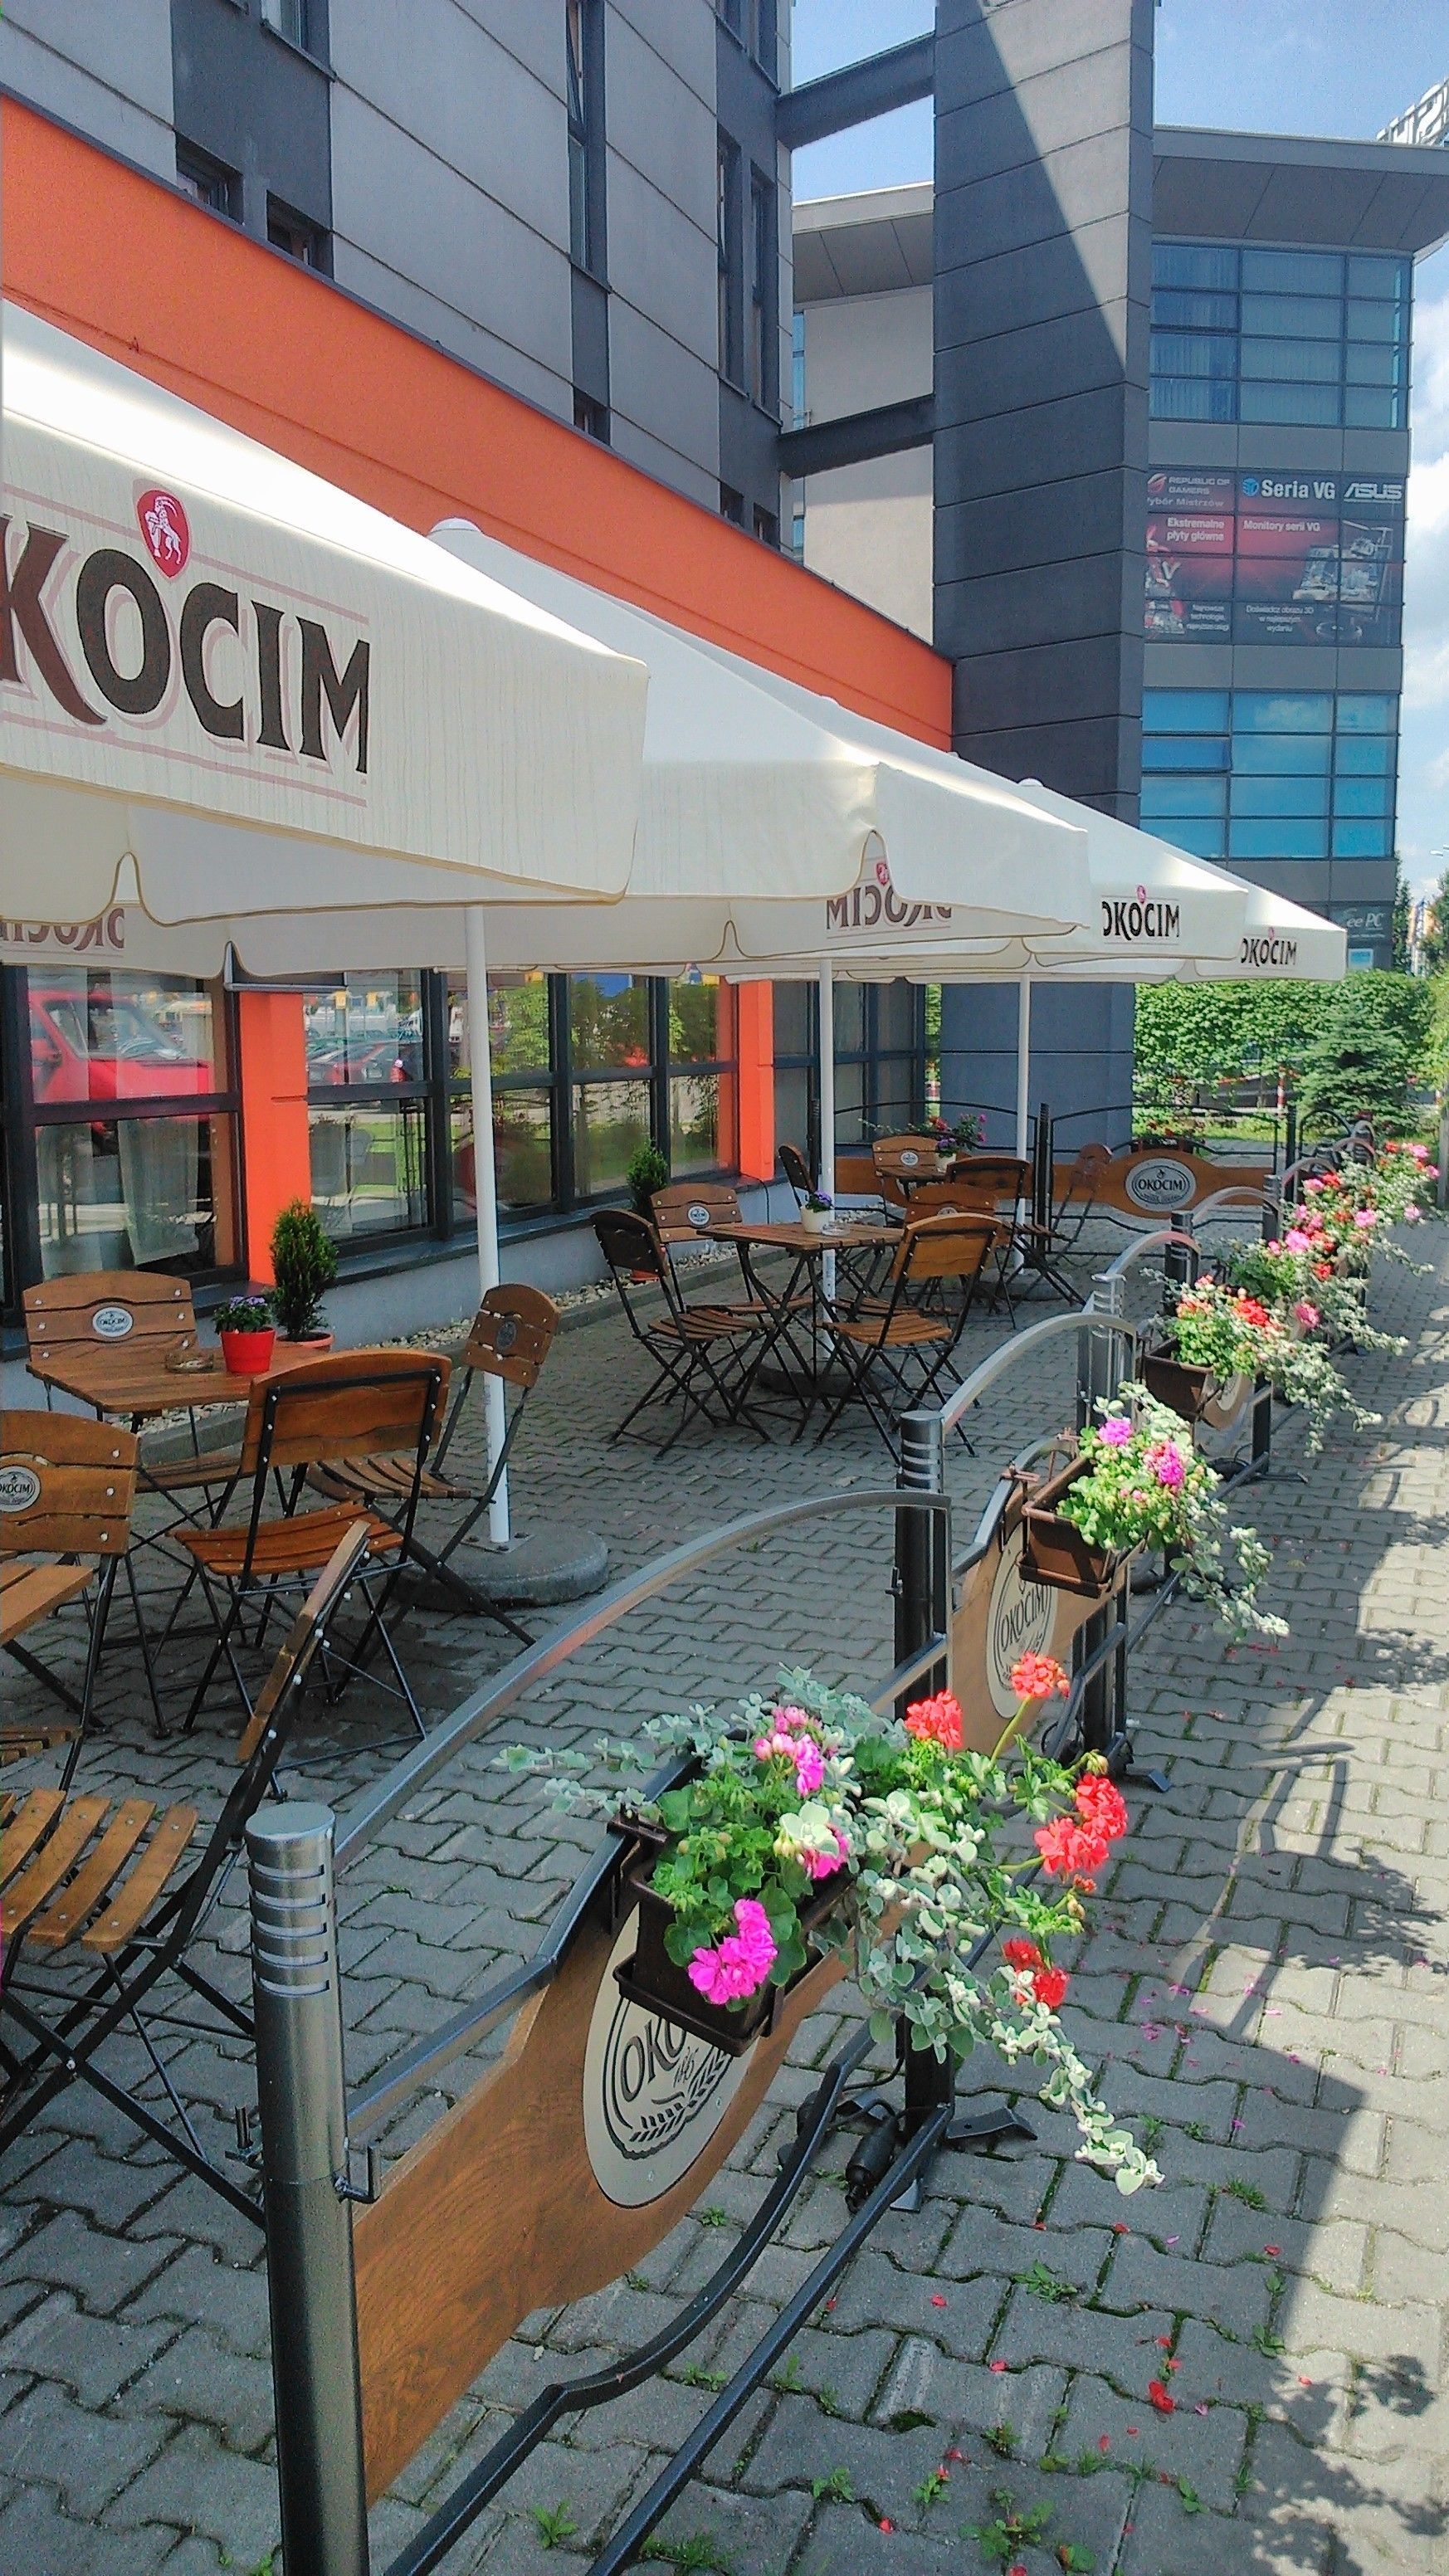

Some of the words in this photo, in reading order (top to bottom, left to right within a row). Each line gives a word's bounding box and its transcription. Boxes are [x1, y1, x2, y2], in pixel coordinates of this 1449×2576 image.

[1168, 476, 1215, 485] REPUBLIC
[1168, 486, 1210, 495] GAMERS
[1261, 479, 1309, 498] Seria
[1313, 481, 1335, 500] VG
[1344, 482, 1403, 500] ASUS
[1167, 517, 1225, 529] Ekstremalne
[1243, 520, 1286, 532] Monitory
[1307, 523, 1320, 532] VG
[1101, 900, 1179, 941] OKOCIM
[1241, 938, 1297, 968] OKOCIM
[1138, 1179, 1183, 1192] OKOCIM
[1001, 1585, 1046, 1652] OKOCIM
